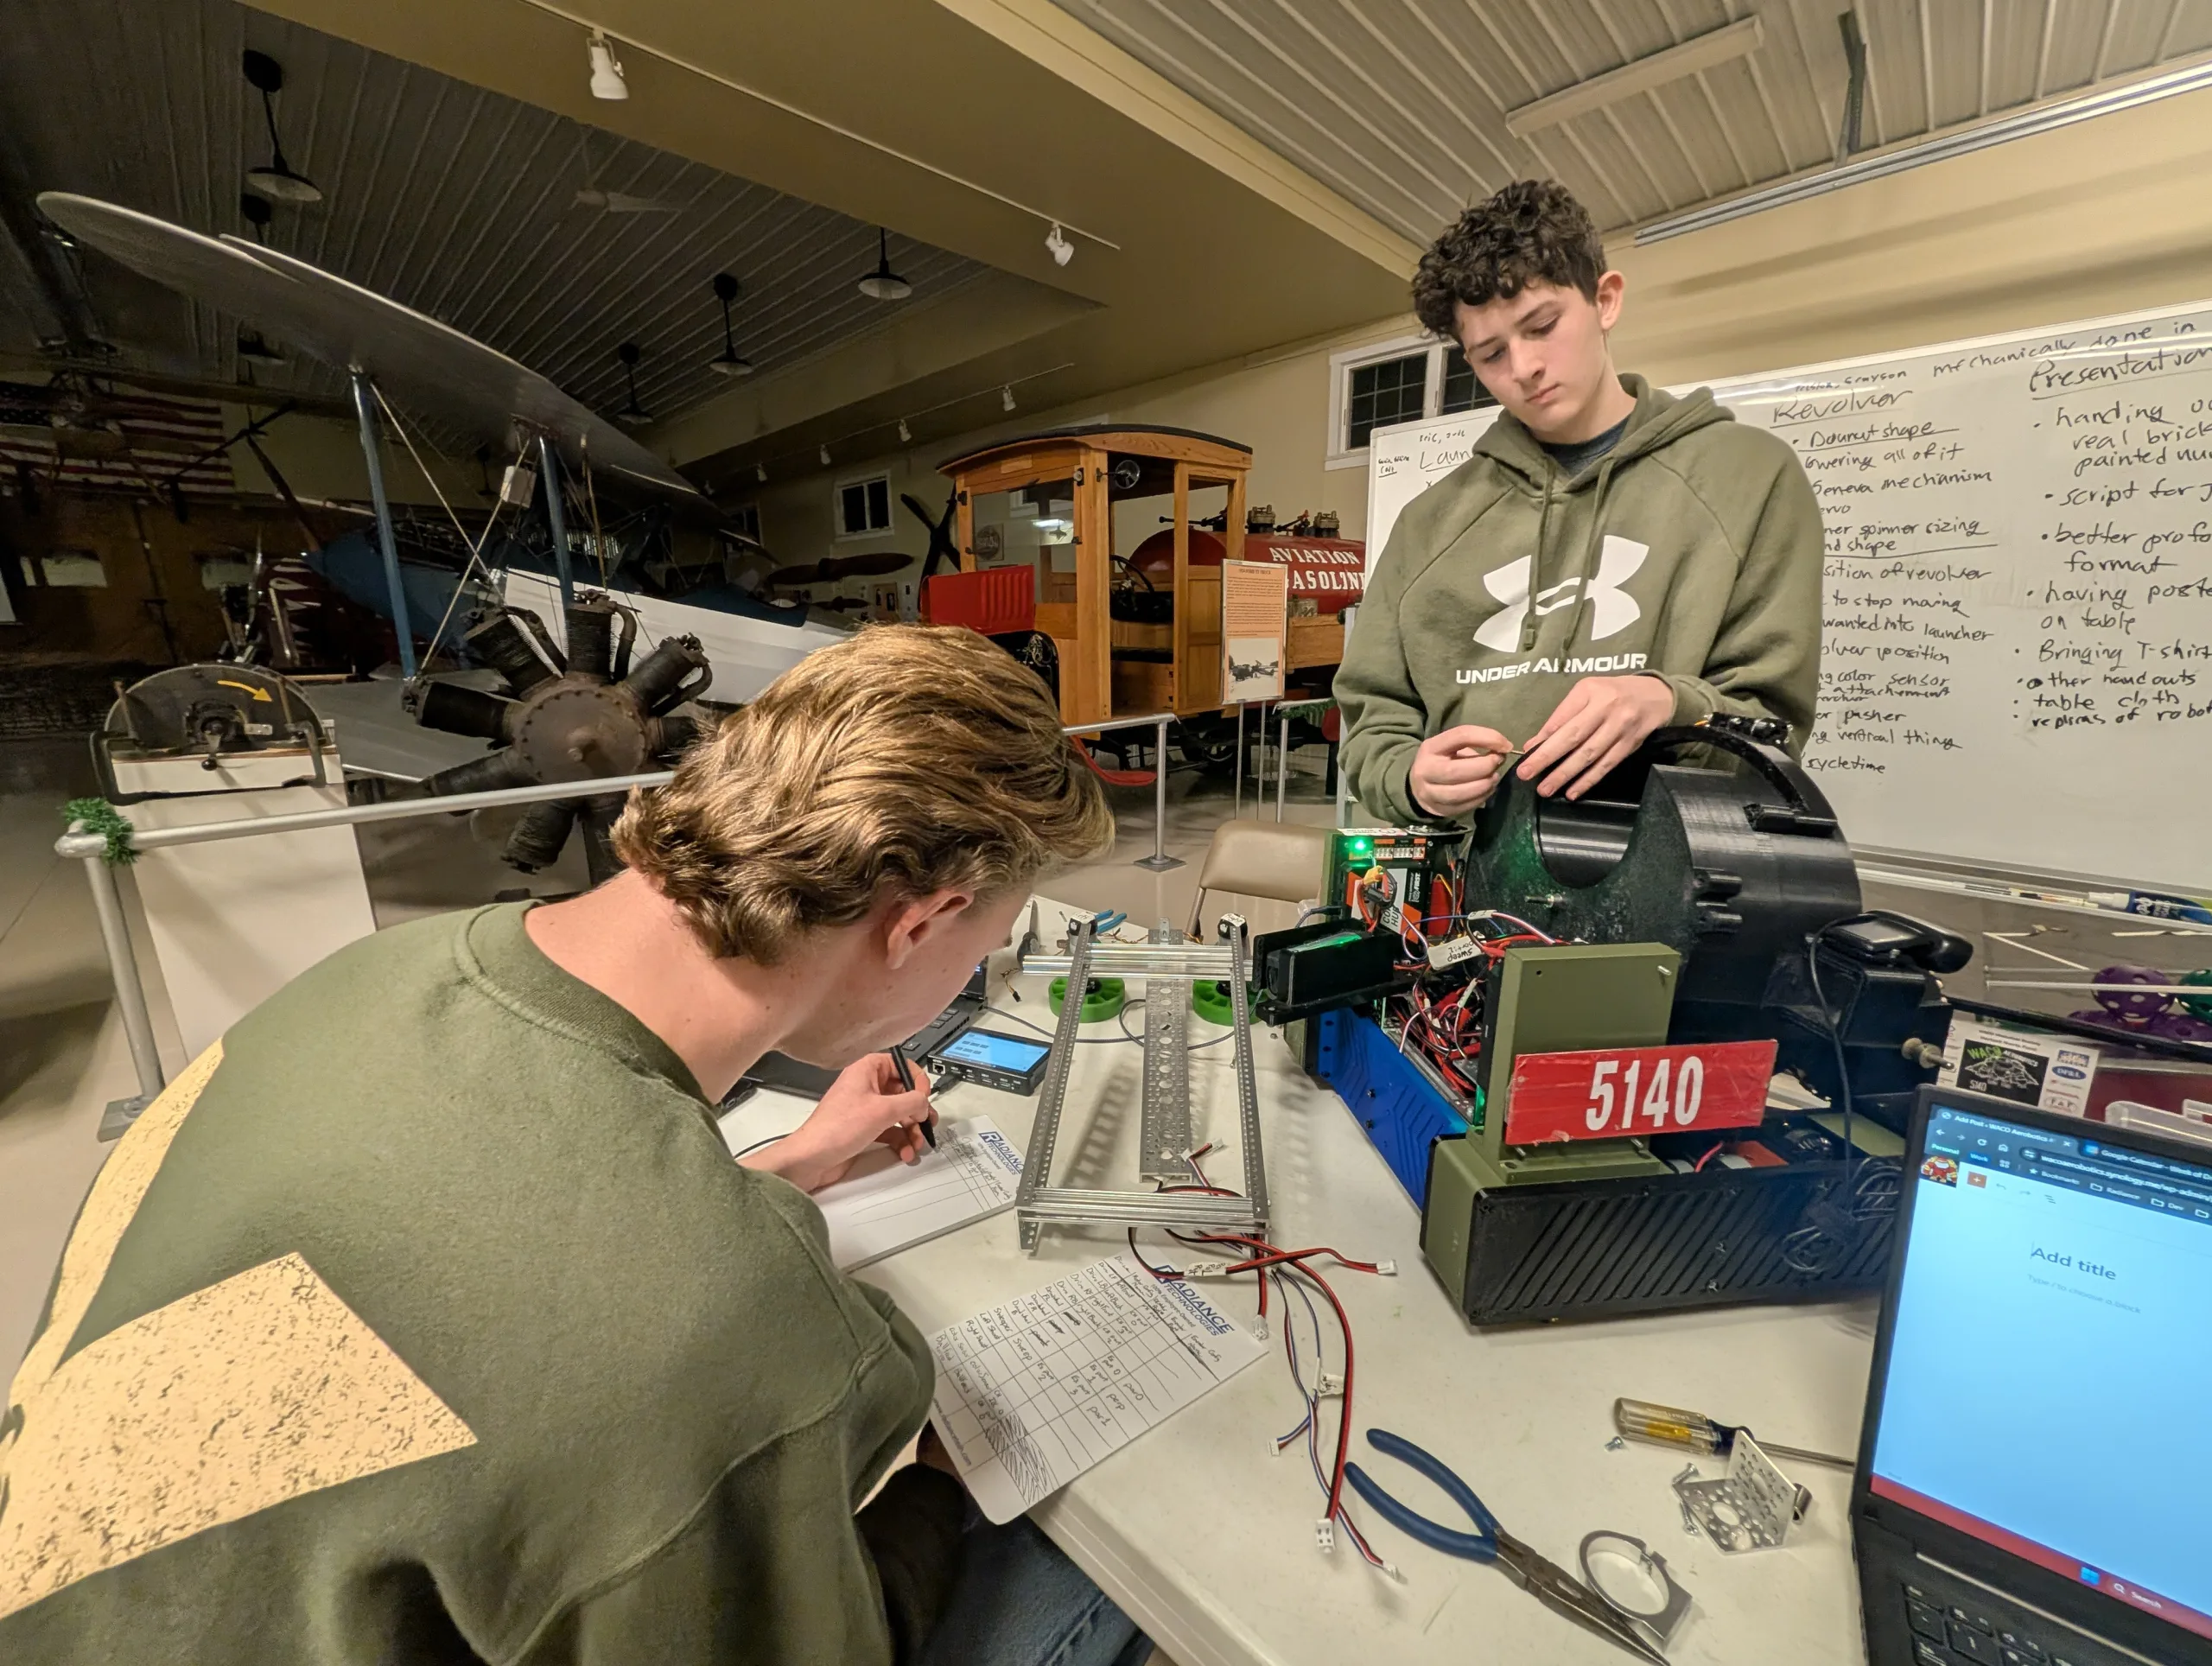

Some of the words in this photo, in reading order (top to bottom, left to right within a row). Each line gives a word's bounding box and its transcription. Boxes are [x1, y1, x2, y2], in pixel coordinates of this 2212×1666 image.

[2174, 321, 2196, 334] in
[1883, 422, 1936, 441] shape
[2073, 429, 2128, 449] real
[1420, 450, 1471, 469] Laun
[1884, 448, 1905, 463] all
[2074, 447, 2166, 477] painted
[2059, 480, 2139, 507] script
[2055, 521, 2138, 544] better
[1268, 547, 1361, 564] AVIATION
[1847, 537, 1897, 556] shape
[2064, 550, 2177, 574] format
[1287, 570, 1365, 590] ASOLIN
[1833, 589, 1847, 605] to
[1853, 593, 1892, 609] stop
[2046, 580, 2133, 610] having
[2041, 615, 2067, 630] on
[2081, 607, 2136, 635] table
[1924, 623, 1994, 641] launcher
[2039, 639, 2129, 671] Bringing
[1456, 661, 1531, 684] UNDER
[1532, 653, 1647, 673] ARMOUR
[1837, 669, 1876, 682] color
[1888, 673, 1950, 687] sensor
[2033, 693, 2094, 711] table
[1904, 728, 1963, 750] thing
[1586, 1056, 1704, 1131] 5140
[1989, 1123, 2011, 1133] WACO
[1931, 1143, 1960, 1155] Personal
[1970, 1153, 1988, 1162] Work
[2031, 1247, 2071, 1267] Add
[2077, 1260, 2116, 1281] title
[1160, 1293, 1196, 1328] Employee-Owned
[1164, 1284, 1219, 1336] TECHNOLOGIES
